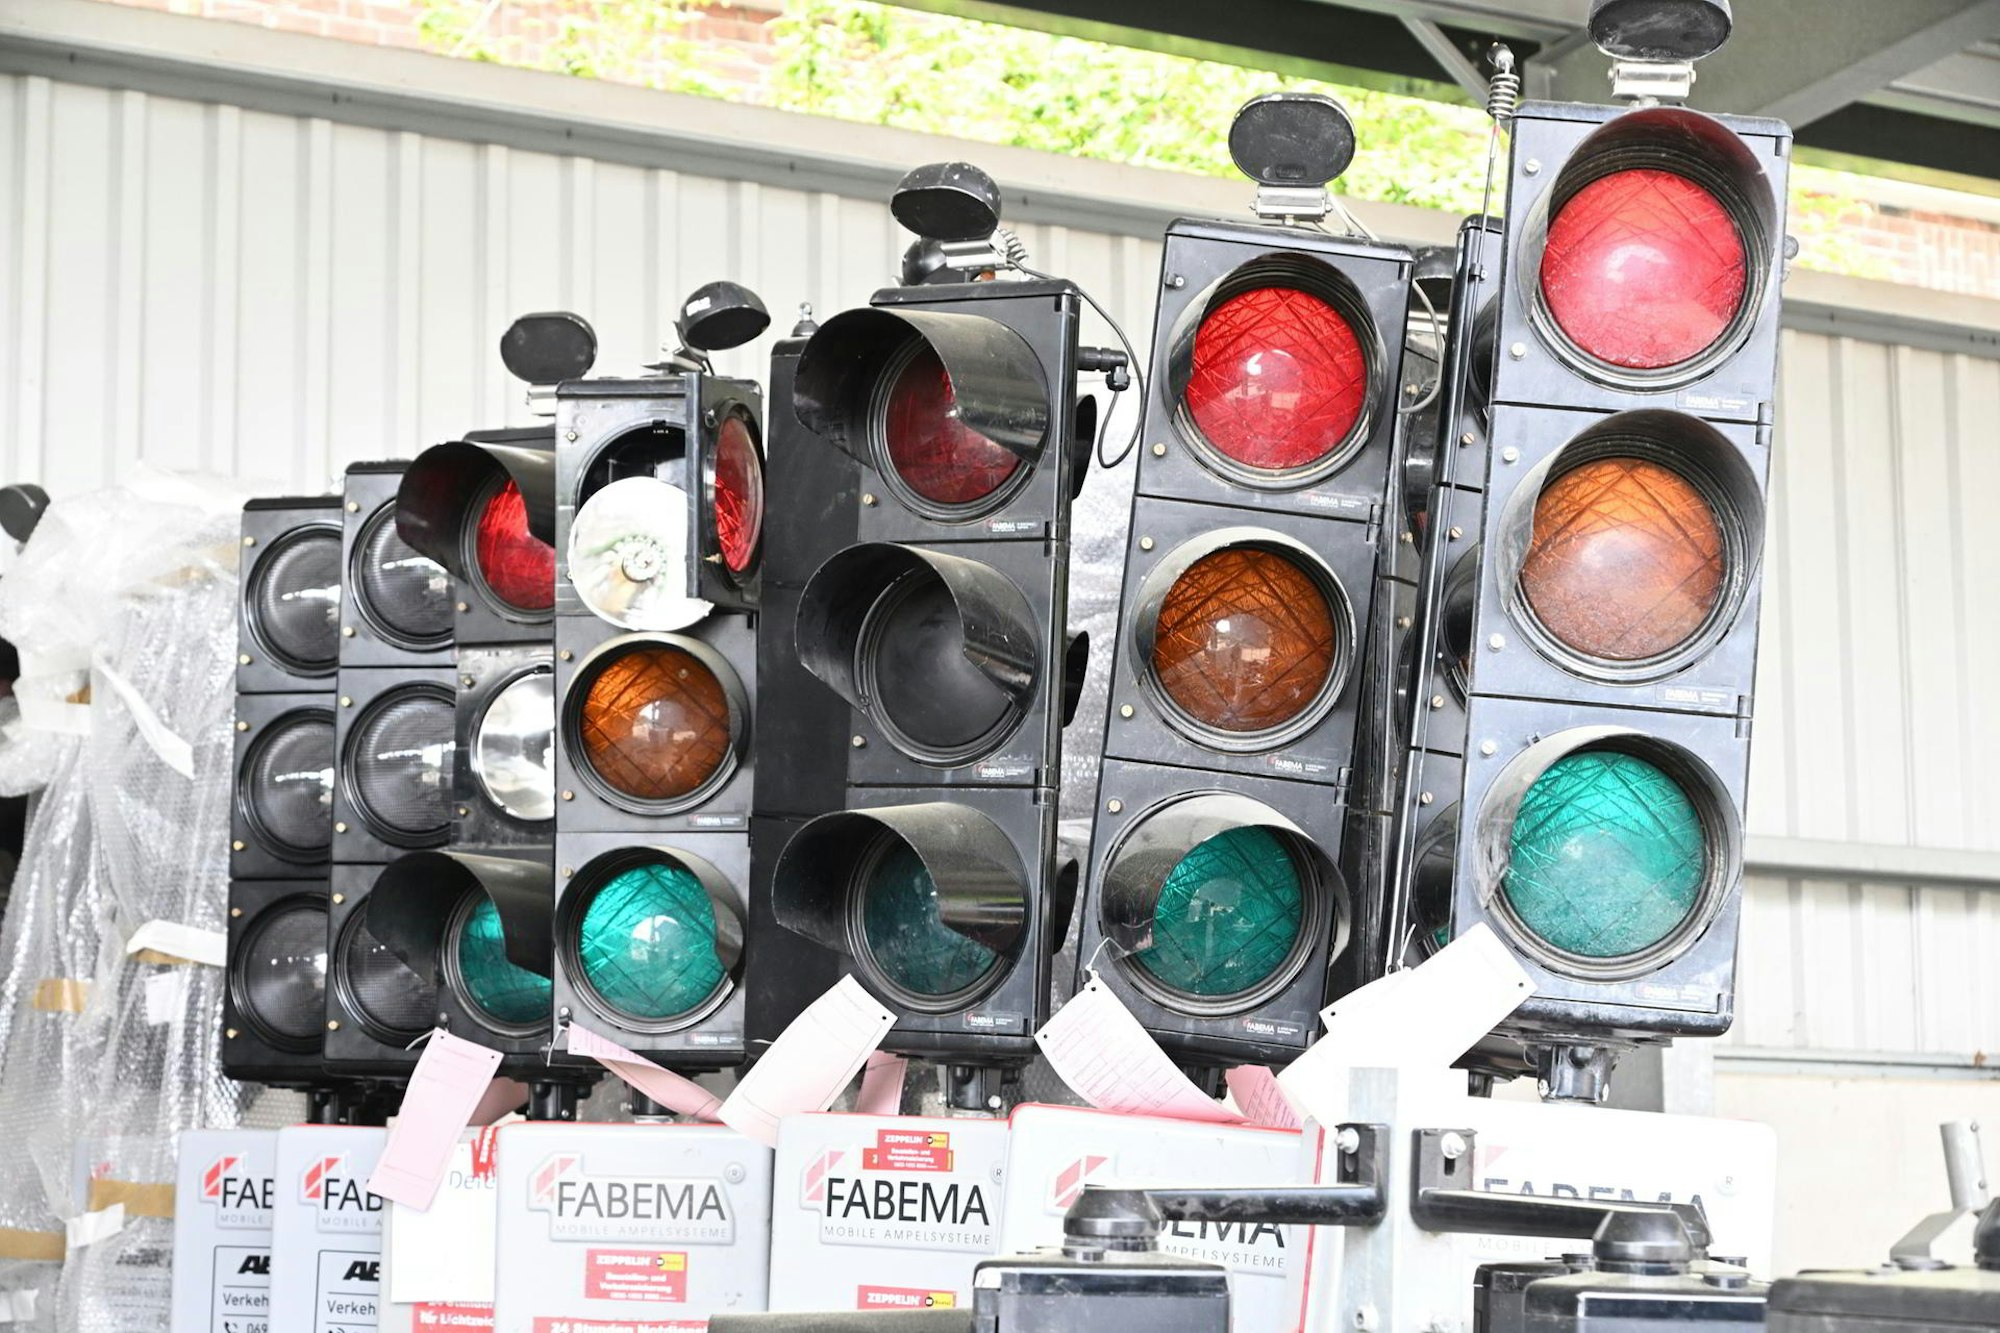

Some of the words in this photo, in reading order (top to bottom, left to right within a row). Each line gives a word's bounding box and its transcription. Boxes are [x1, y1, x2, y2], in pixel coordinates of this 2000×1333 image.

[884, 1135, 924, 1144] ZEPPELIN
[557, 1181, 726, 1221] FABEMA
[826, 1177, 990, 1226] FABEMA
[221, 1214, 264, 1224] MOBILE
[322, 1217, 366, 1227] MOBILE
[555, 1224, 609, 1236] MOBILE
[618, 1225, 727, 1238] AMPELSYSTEME
[825, 1226, 876, 1239] MOBILE
[884, 1229, 991, 1245] AMPELSYSTEME
[596, 1255, 651, 1267] ZEPPELIN
[223, 1293, 269, 1307] Verkeh
[867, 1292, 920, 1306] ZEPPELIN
[327, 1299, 376, 1316] Verkeh
